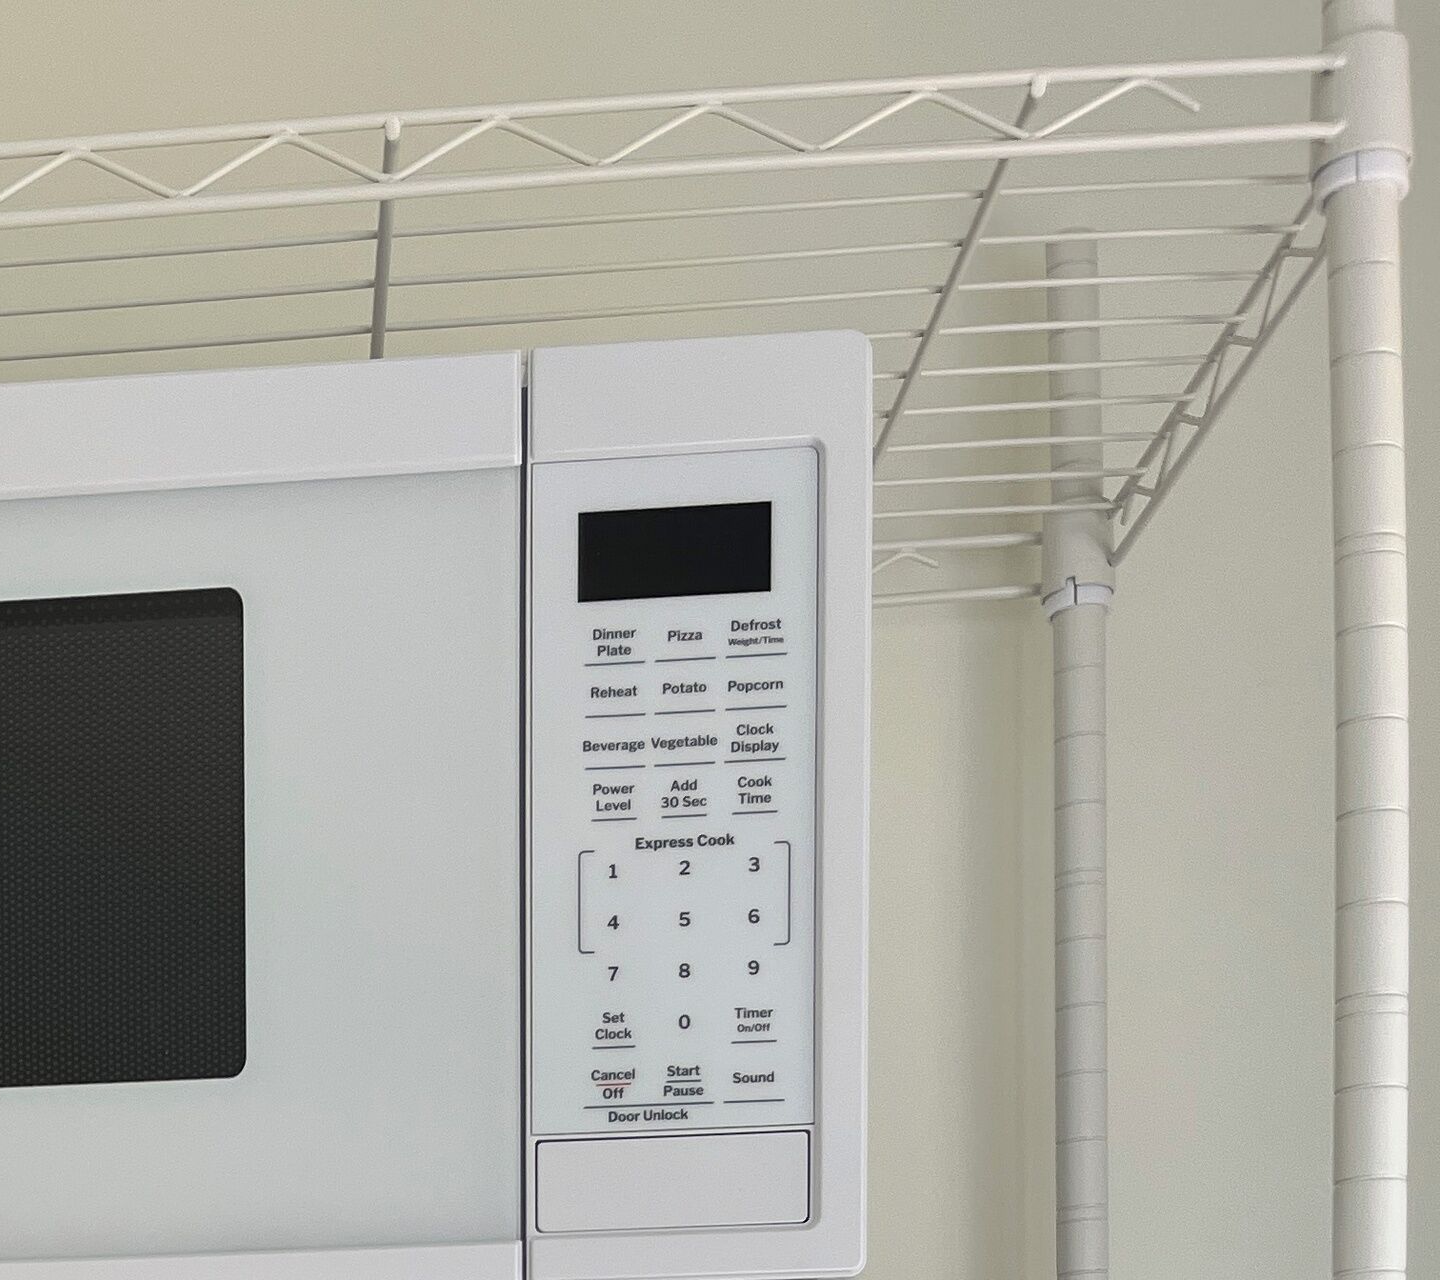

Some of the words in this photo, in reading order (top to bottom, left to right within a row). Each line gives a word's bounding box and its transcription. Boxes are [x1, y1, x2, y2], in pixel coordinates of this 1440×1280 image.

[731, 618, 781, 632] Defrost
[593, 628, 637, 640] Dinner
[668, 630, 703, 642] Pizza
[597, 644, 632, 656] Plate
[591, 685, 638, 698] Reheat
[663, 682, 707, 695] Potato
[728, 681, 783, 693] Popcorn
[736, 723, 774, 736] Clock
[583, 740, 645, 752] Beverage
[651, 735, 718, 750] Vegetable
[731, 740, 779, 754] Display
[670, 779, 697, 792] Add
[738, 775, 772, 788] Cook
[593, 784, 635, 795] Power
[661, 796, 679, 808] 30
[682, 796, 707, 807] Sec
[738, 792, 771, 804] Time
[596, 799, 631, 812] Level
[635, 837, 693, 851] Express
[697, 833, 735, 847] Cook
[679, 860, 690, 876] 2
[749, 857, 760, 872] 3
[609, 864, 618, 879] 1
[607, 915, 620, 930] 4
[679, 912, 691, 927] 5
[748, 909, 760, 924] 6
[608, 966, 619, 981] 7
[679, 963, 691, 978] 8
[748, 960, 760, 975] 9
[602, 1012, 625, 1024] Set
[734, 1007, 773, 1019] Timer
[679, 1014, 691, 1029] 0
[737, 1023, 770, 1032] On/Off
[595, 1028, 632, 1040] Clock
[591, 1068, 635, 1081] Cancel
[667, 1065, 701, 1077] Start
[733, 1071, 774, 1084] Sound
[603, 1087, 624, 1099] Off
[663, 1085, 704, 1096] Pause
[608, 1111, 640, 1122] Door
[643, 1108, 688, 1121] Unlock
